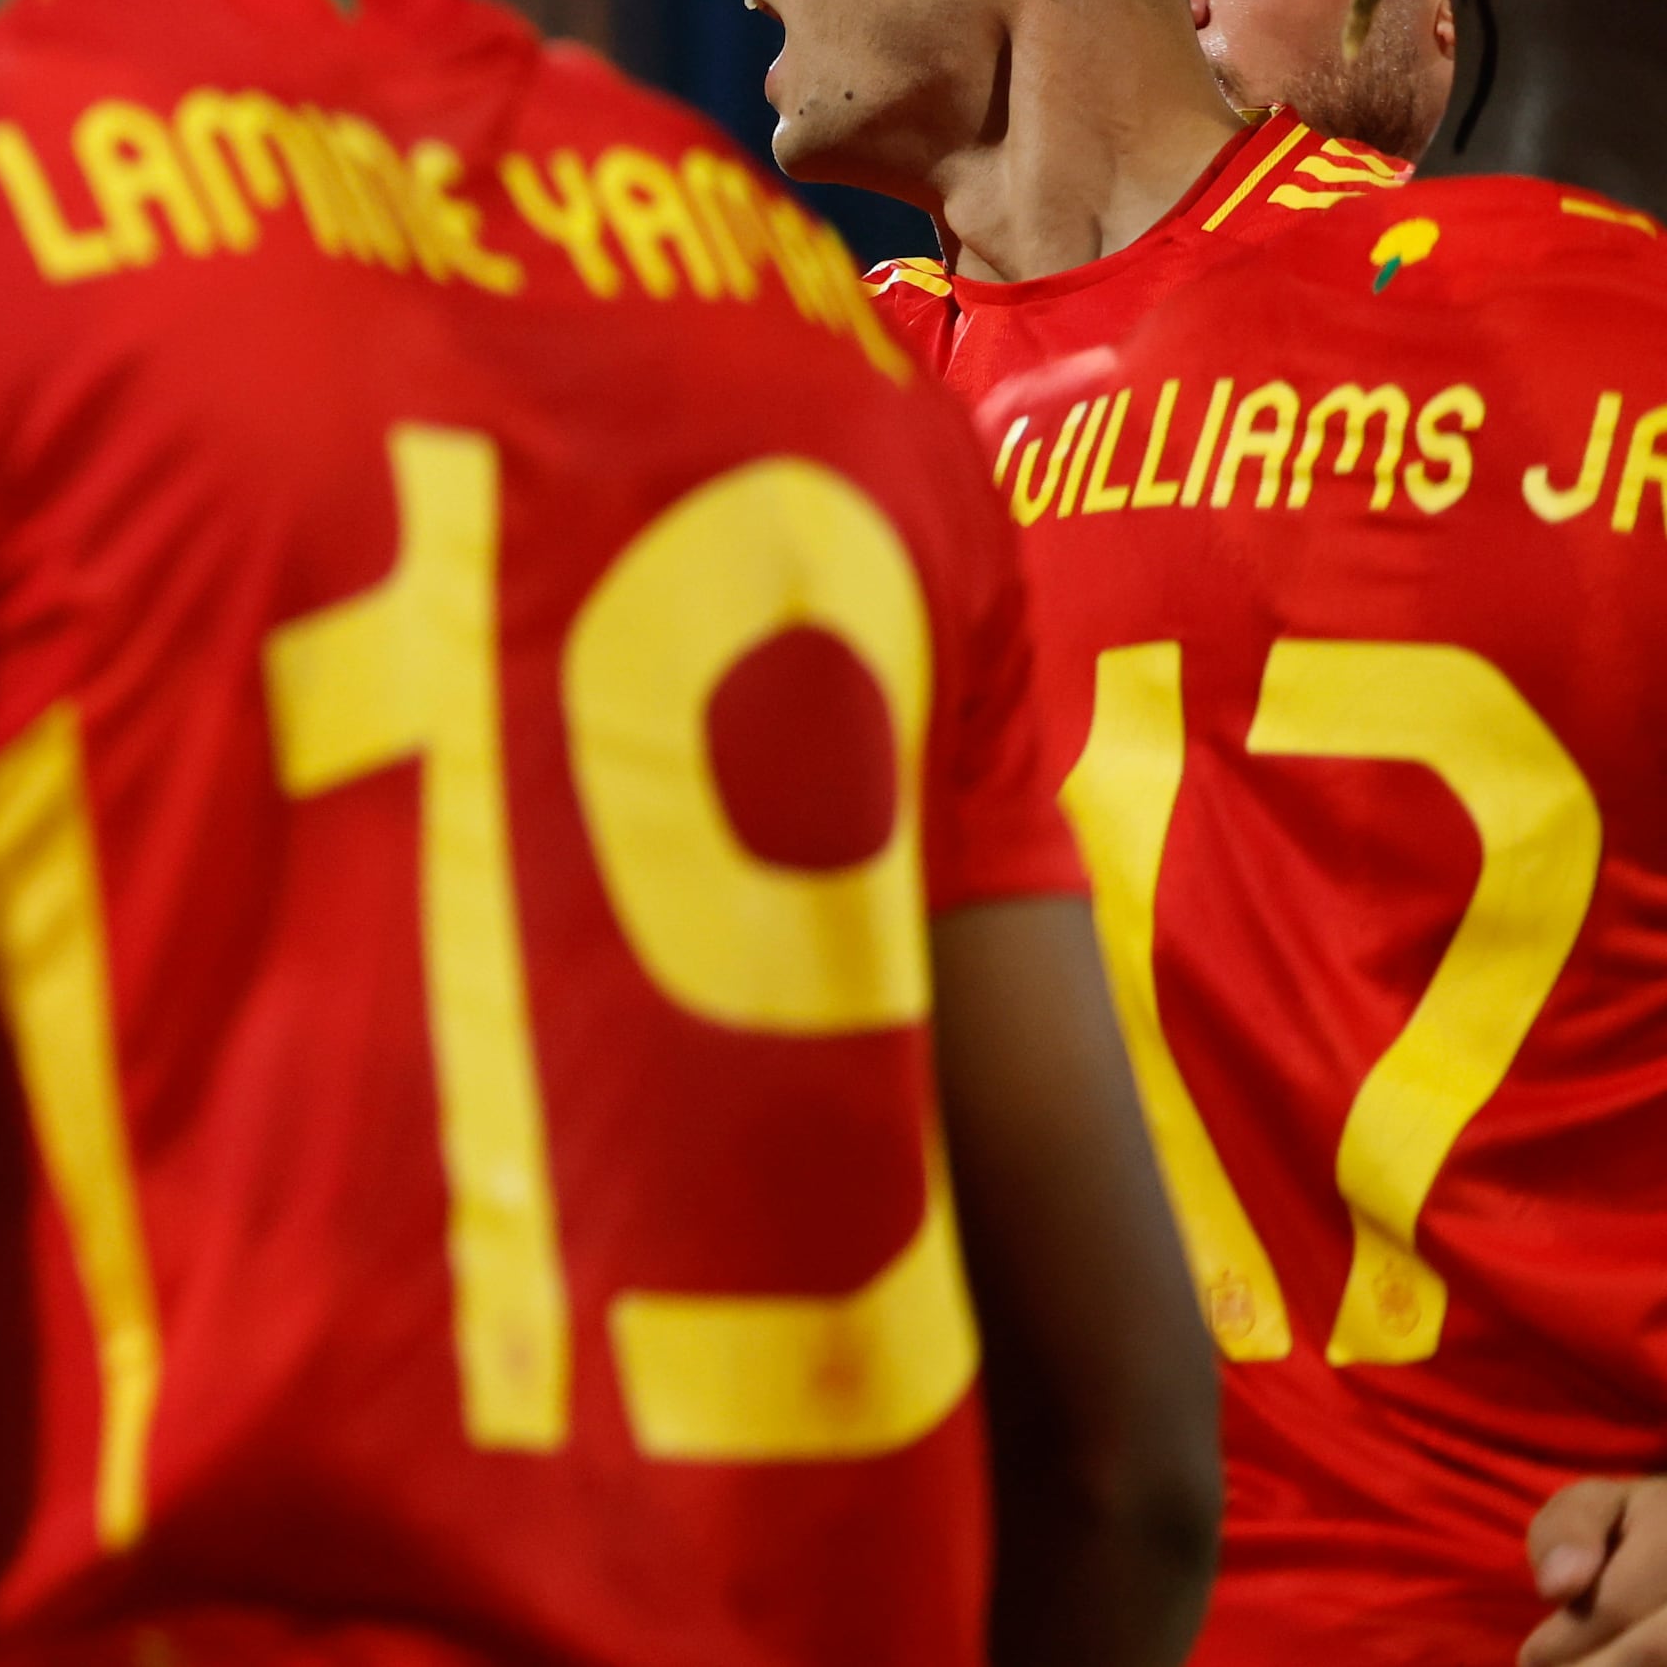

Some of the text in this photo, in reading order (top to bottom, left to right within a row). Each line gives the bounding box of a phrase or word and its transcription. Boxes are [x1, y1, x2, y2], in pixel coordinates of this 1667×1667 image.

[993, 377, 1486, 528] WILLIAMS
[267, 421, 980, 1460] 19
[1058, 639, 1602, 1365] 17
